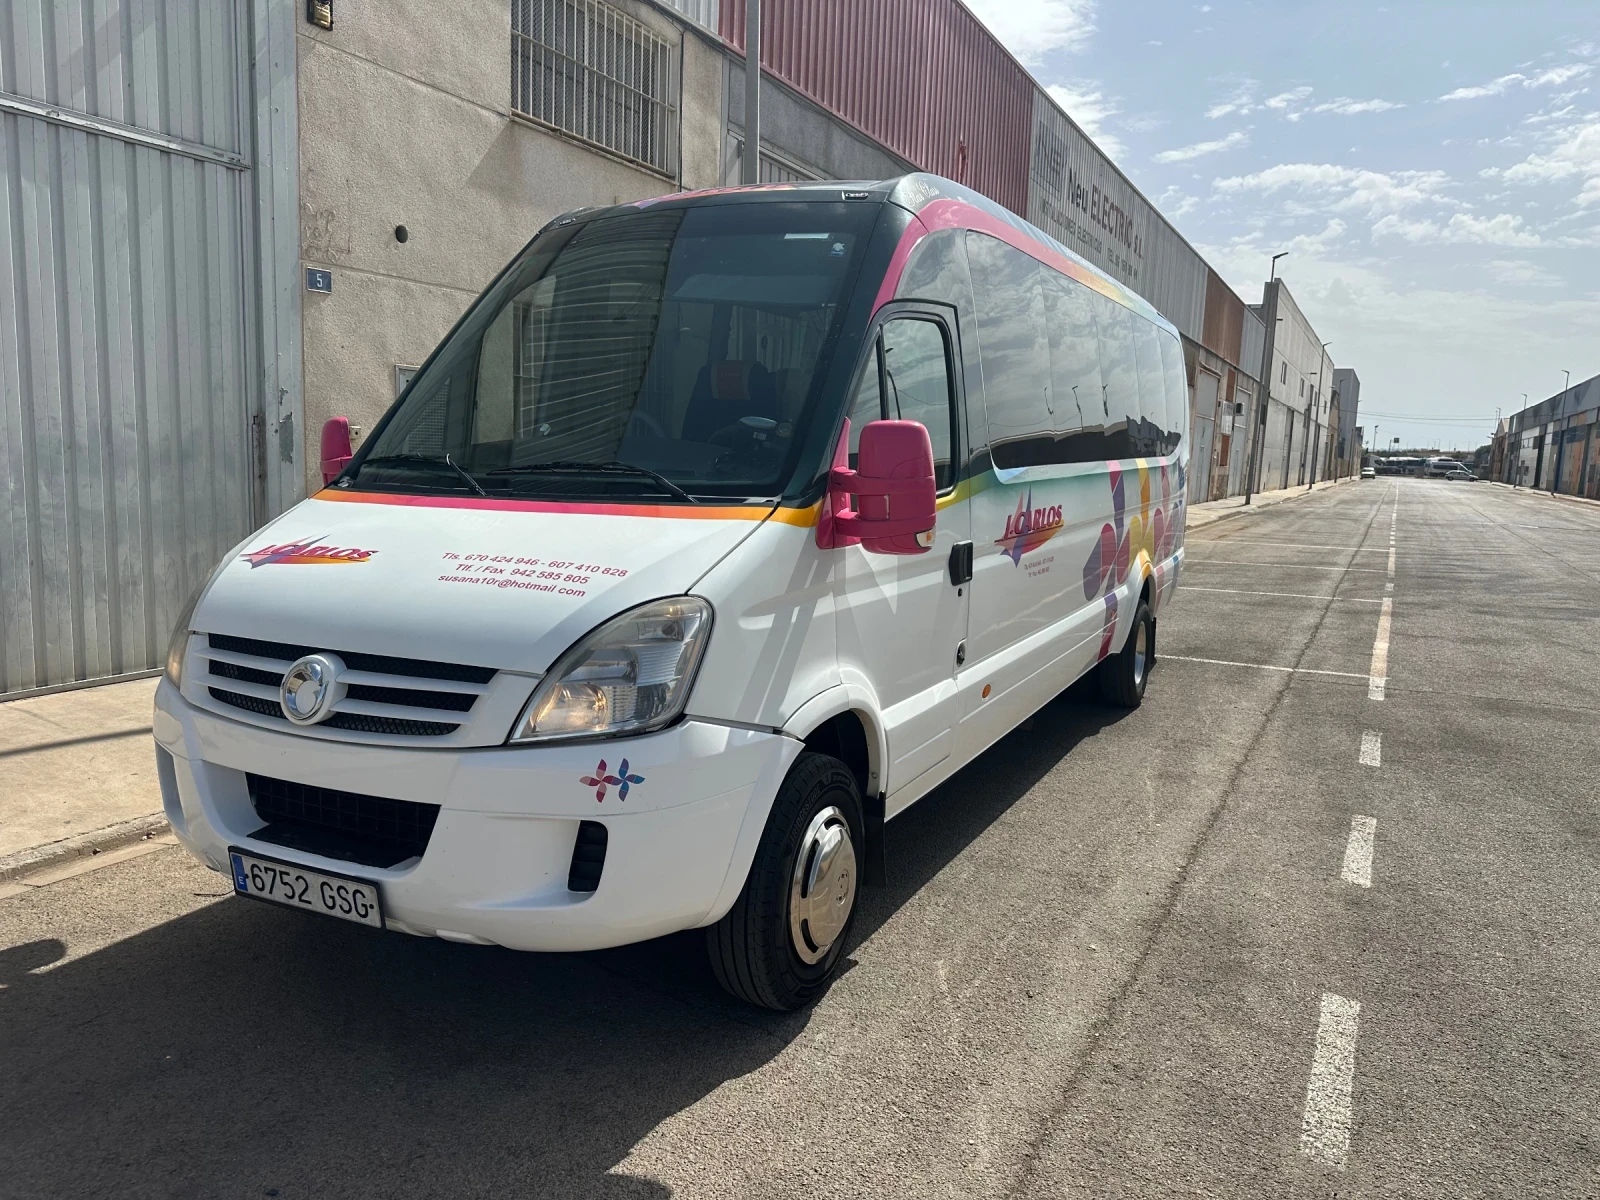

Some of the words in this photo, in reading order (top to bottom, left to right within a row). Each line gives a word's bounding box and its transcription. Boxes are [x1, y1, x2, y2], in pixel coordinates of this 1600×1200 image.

[1090, 183, 1133, 249] ELECTRIC
[316, 273, 323, 288] 5
[1003, 504, 1063, 541] J.CARLOS
[442, 552, 461, 561] Tls.
[464, 553, 489, 562] 670
[489, 555, 514, 564] 424
[514, 557, 540, 566] 946
[548, 560, 574, 570] 607
[574, 563, 600, 574] 410
[601, 567, 629, 578] 828
[482, 565, 505, 575] Fax
[509, 567, 536, 578] 942
[536, 571, 561, 581] 585
[563, 574, 591, 585] 805
[239, 876, 244, 885] E
[250, 863, 312, 905] 6752
[320, 881, 369, 919] GSG
